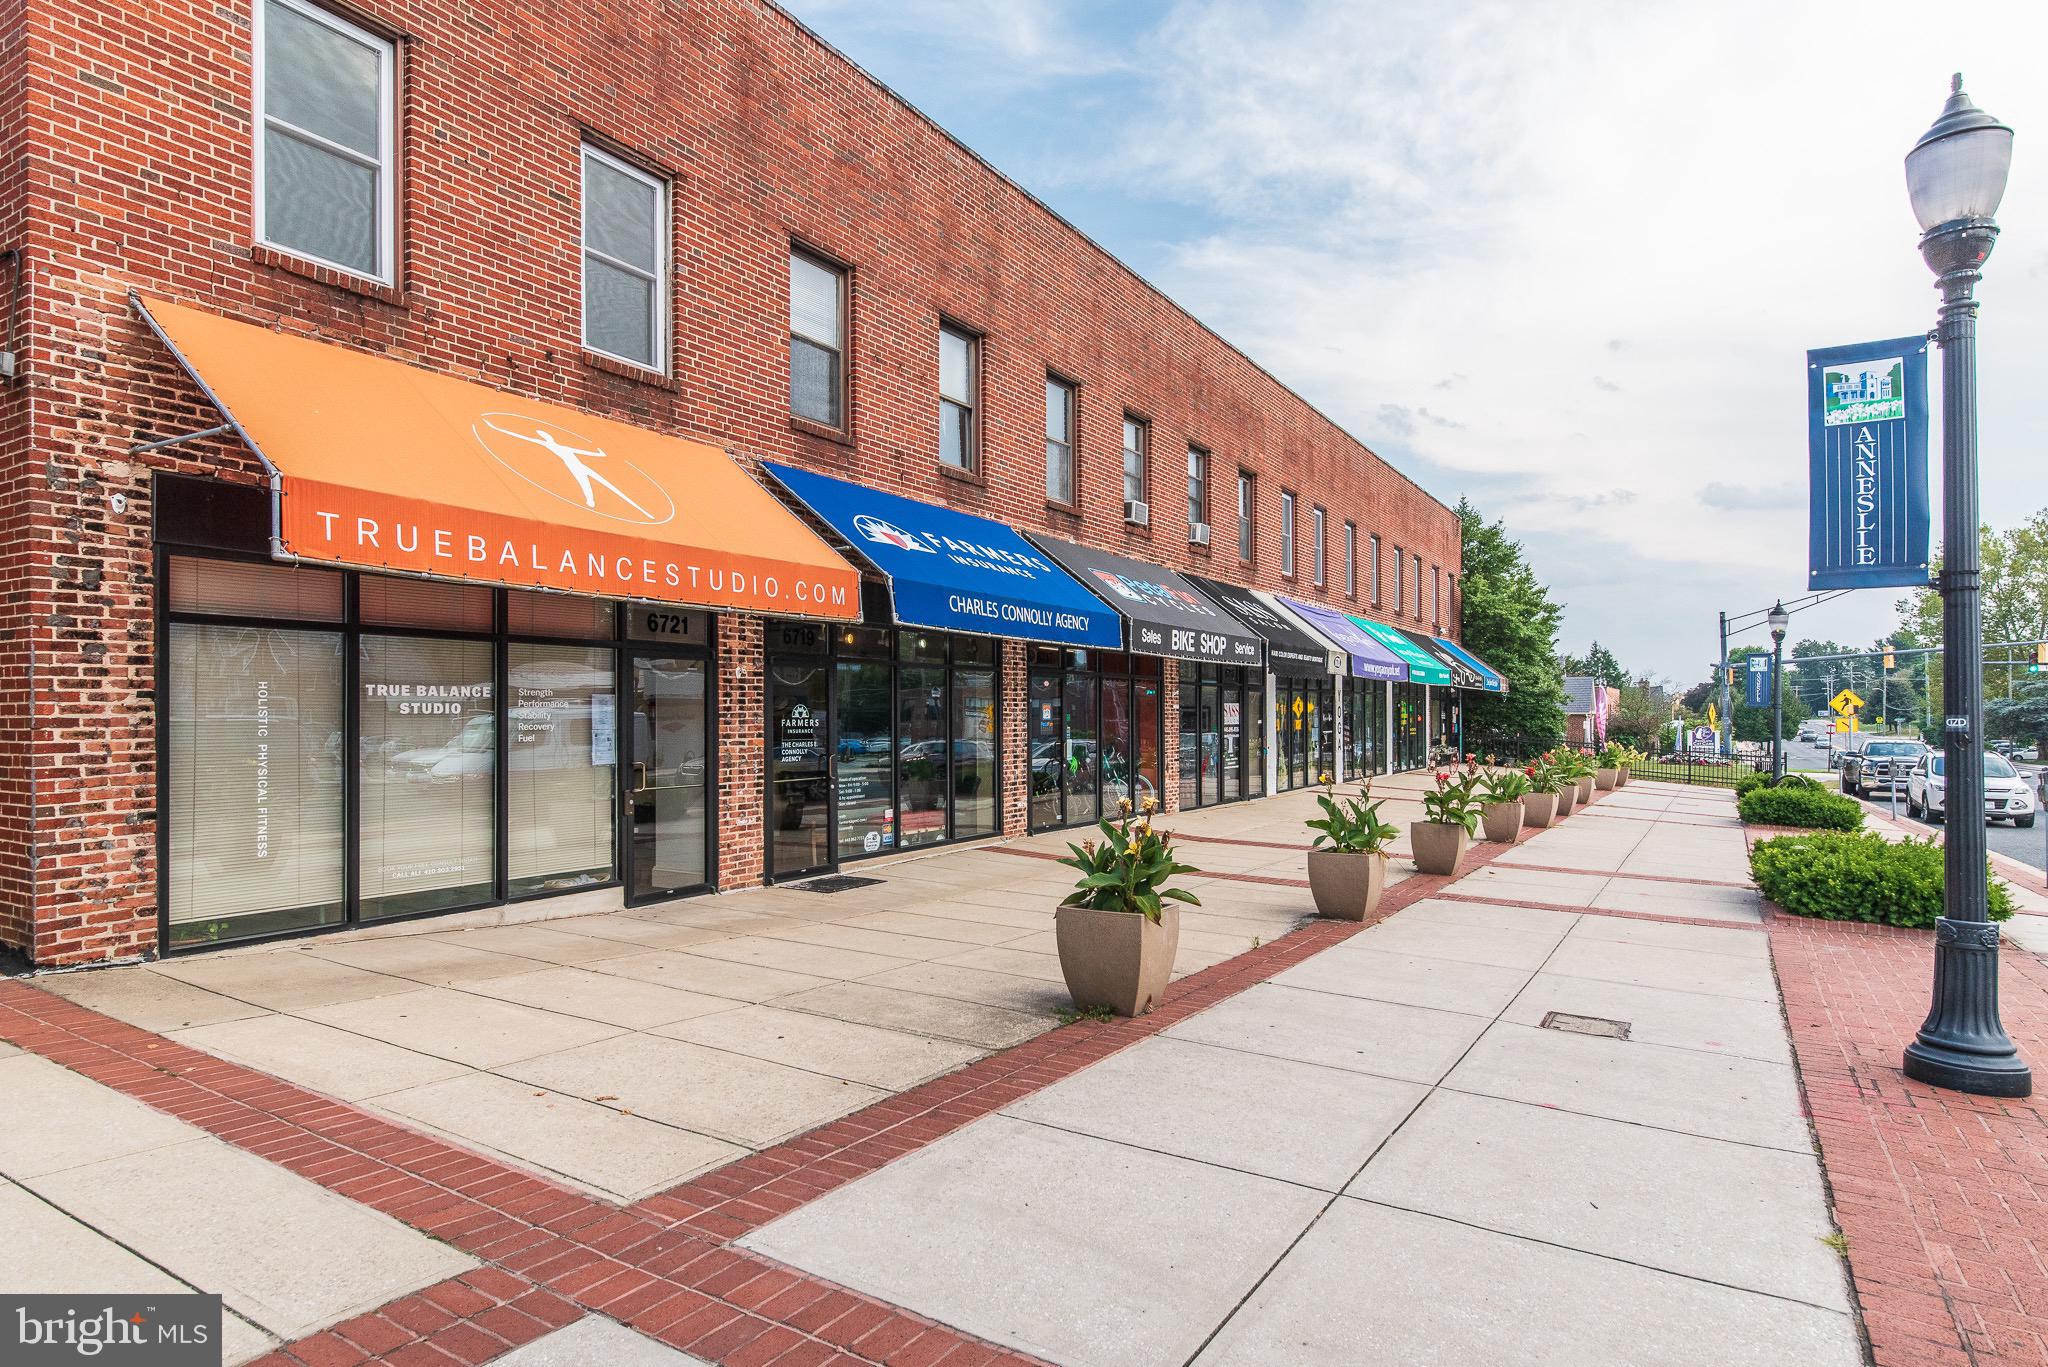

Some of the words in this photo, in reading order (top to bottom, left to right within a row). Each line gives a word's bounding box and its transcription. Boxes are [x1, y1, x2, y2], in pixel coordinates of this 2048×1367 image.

[1854, 426, 1877, 565] ANNESLIE
[316, 510, 846, 606] TRUEBALANCESTUDIO.COM
[920, 531, 1051, 573] FARMERS
[947, 553, 1037, 580] INSURANCE
[949, 594, 999, 619] CHARLES
[1001, 603, 1053, 627] CONNOLLY
[1055, 612, 1090, 632] AGENCY
[1141, 593, 1217, 617] CYCLES
[647, 612, 689, 635] 6721
[783, 627, 815, 647] 6719
[1141, 627, 1162, 645] Sales
[1171, 629, 1196, 652] BIKE
[1200, 632, 1227, 656] SHOP
[1234, 641, 1255, 656] Service
[366, 684, 410, 697] TRUE
[416, 684, 491, 698] BALANCE
[518, 687, 553, 698] Strength
[257, 681, 268, 737] HOLISTIC
[399, 702, 462, 715] STUDIO
[518, 700, 569, 708] Performance
[518, 711, 552, 721] Stability
[518, 722, 555, 733] Recovery
[781, 719, 820, 727] FARMERS
[518, 734, 535, 743] Fuel
[257, 744, 268, 804] PHYSICAL
[257, 807, 268, 859] FITNESS
